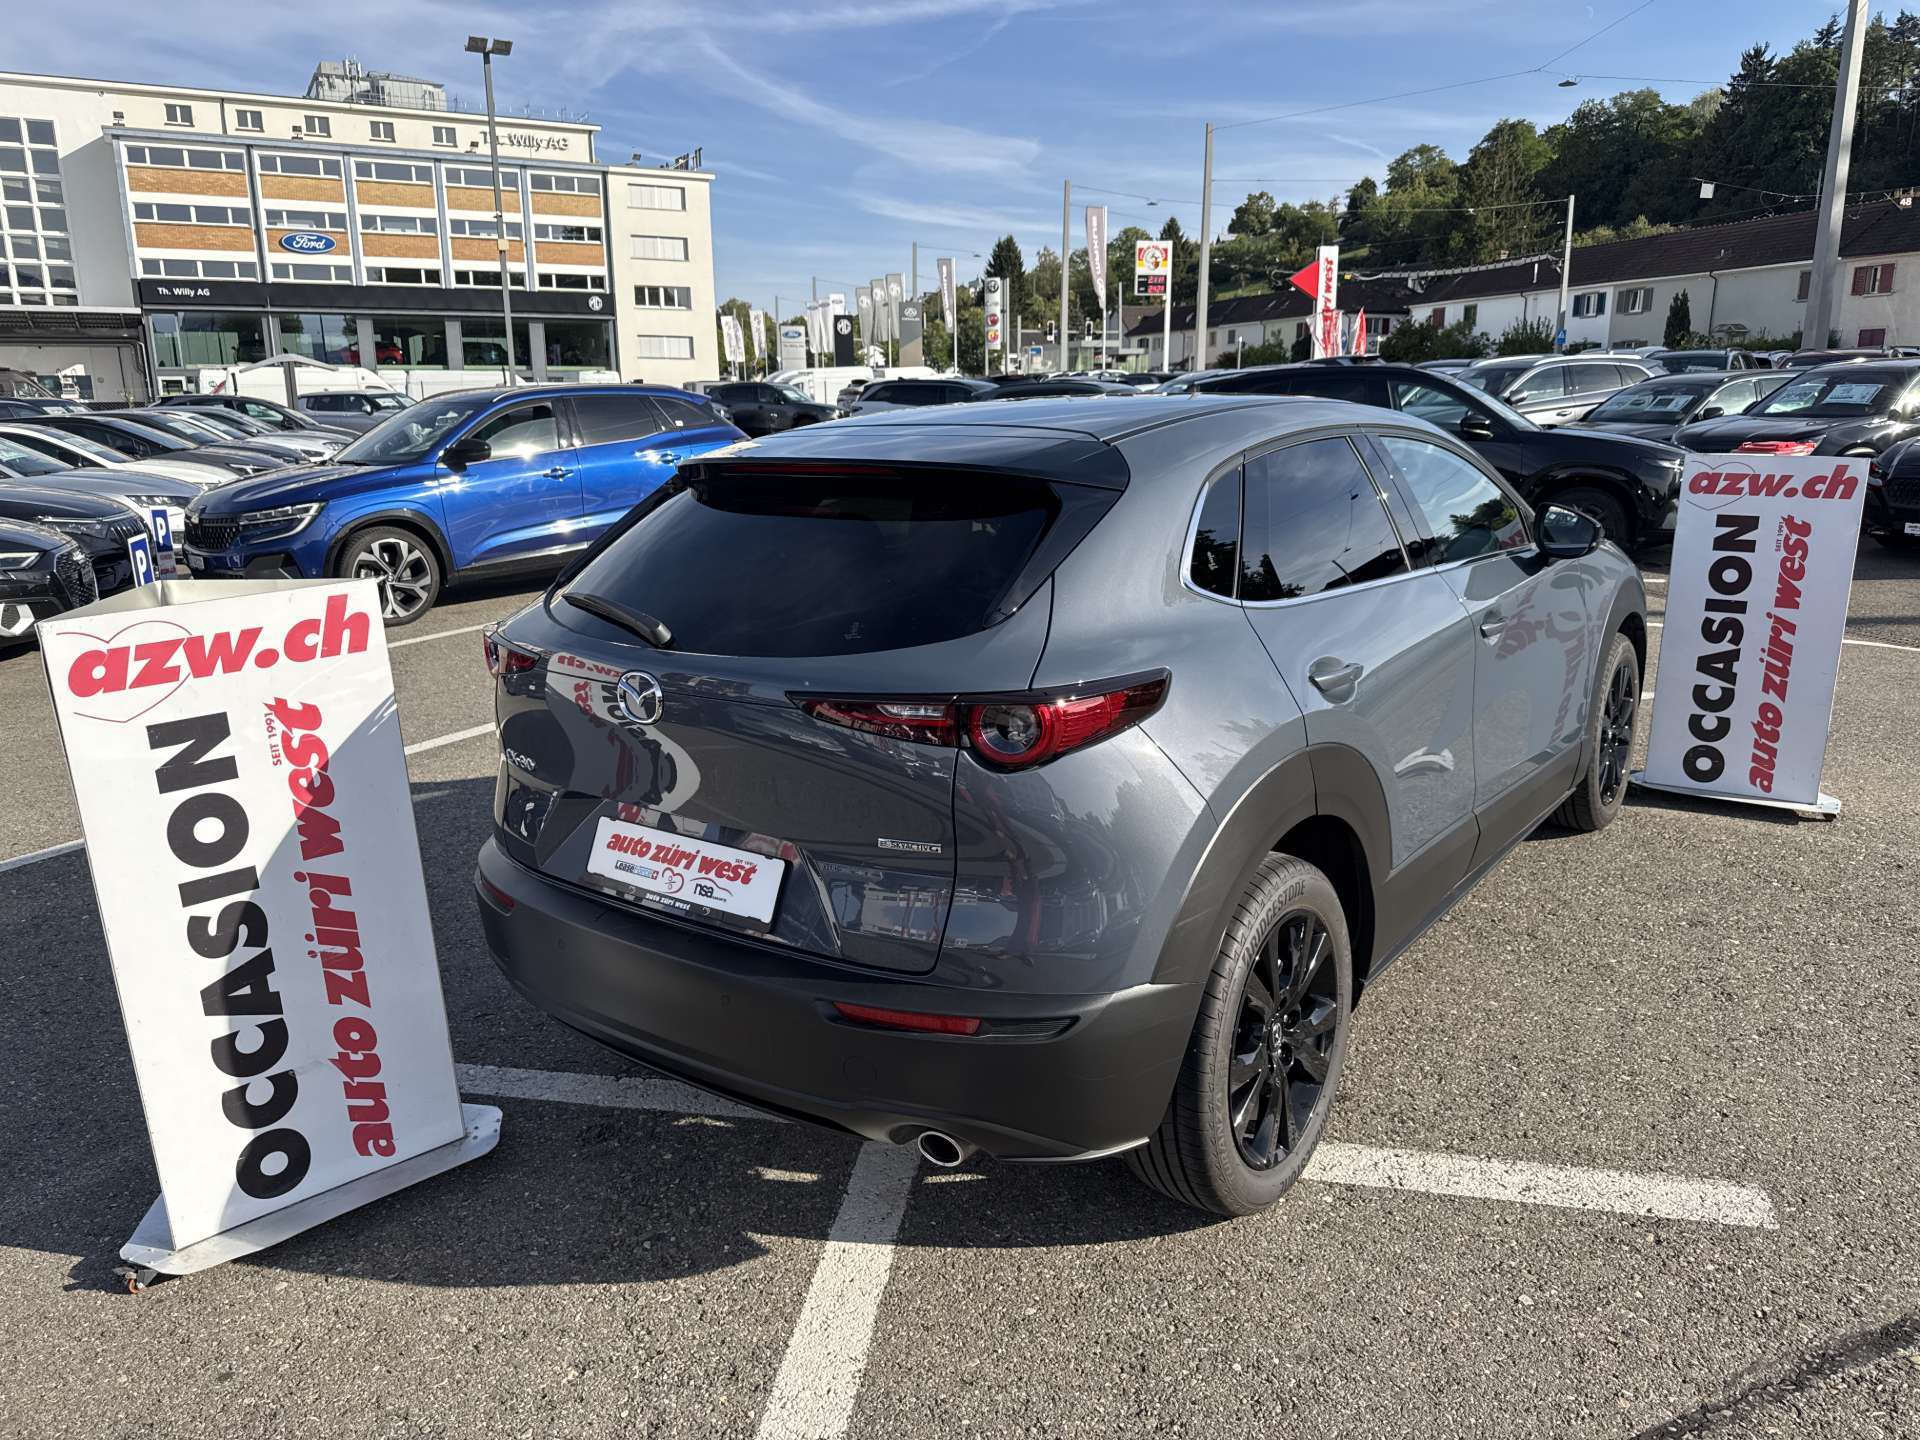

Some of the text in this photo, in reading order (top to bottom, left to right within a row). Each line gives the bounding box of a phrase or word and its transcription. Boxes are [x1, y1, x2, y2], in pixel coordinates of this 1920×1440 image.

[508, 133, 542, 152] Willy
[544, 136, 569, 151] AG
[1899, 197, 1912, 206] 48
[292, 234, 326, 249] Ford
[157, 287, 210, 298] Th. Willy AG
[837, 319, 851, 335] MG
[1688, 464, 1859, 500] azw.ch
[155, 517, 166, 546] P
[135, 549, 147, 586] P
[67, 593, 371, 698] azw.ch
[1682, 514, 1760, 783] OCCASION
[1749, 514, 1812, 794] auto züri west
[264, 711, 283, 767] SEIT 1991
[606, 833, 757, 885] auto züri west
[645, 893, 691, 910] auto züri west
[693, 883, 713, 898] nsa
[262, 696, 397, 1158] auto züri west
[145, 711, 311, 1199] OCCASION
